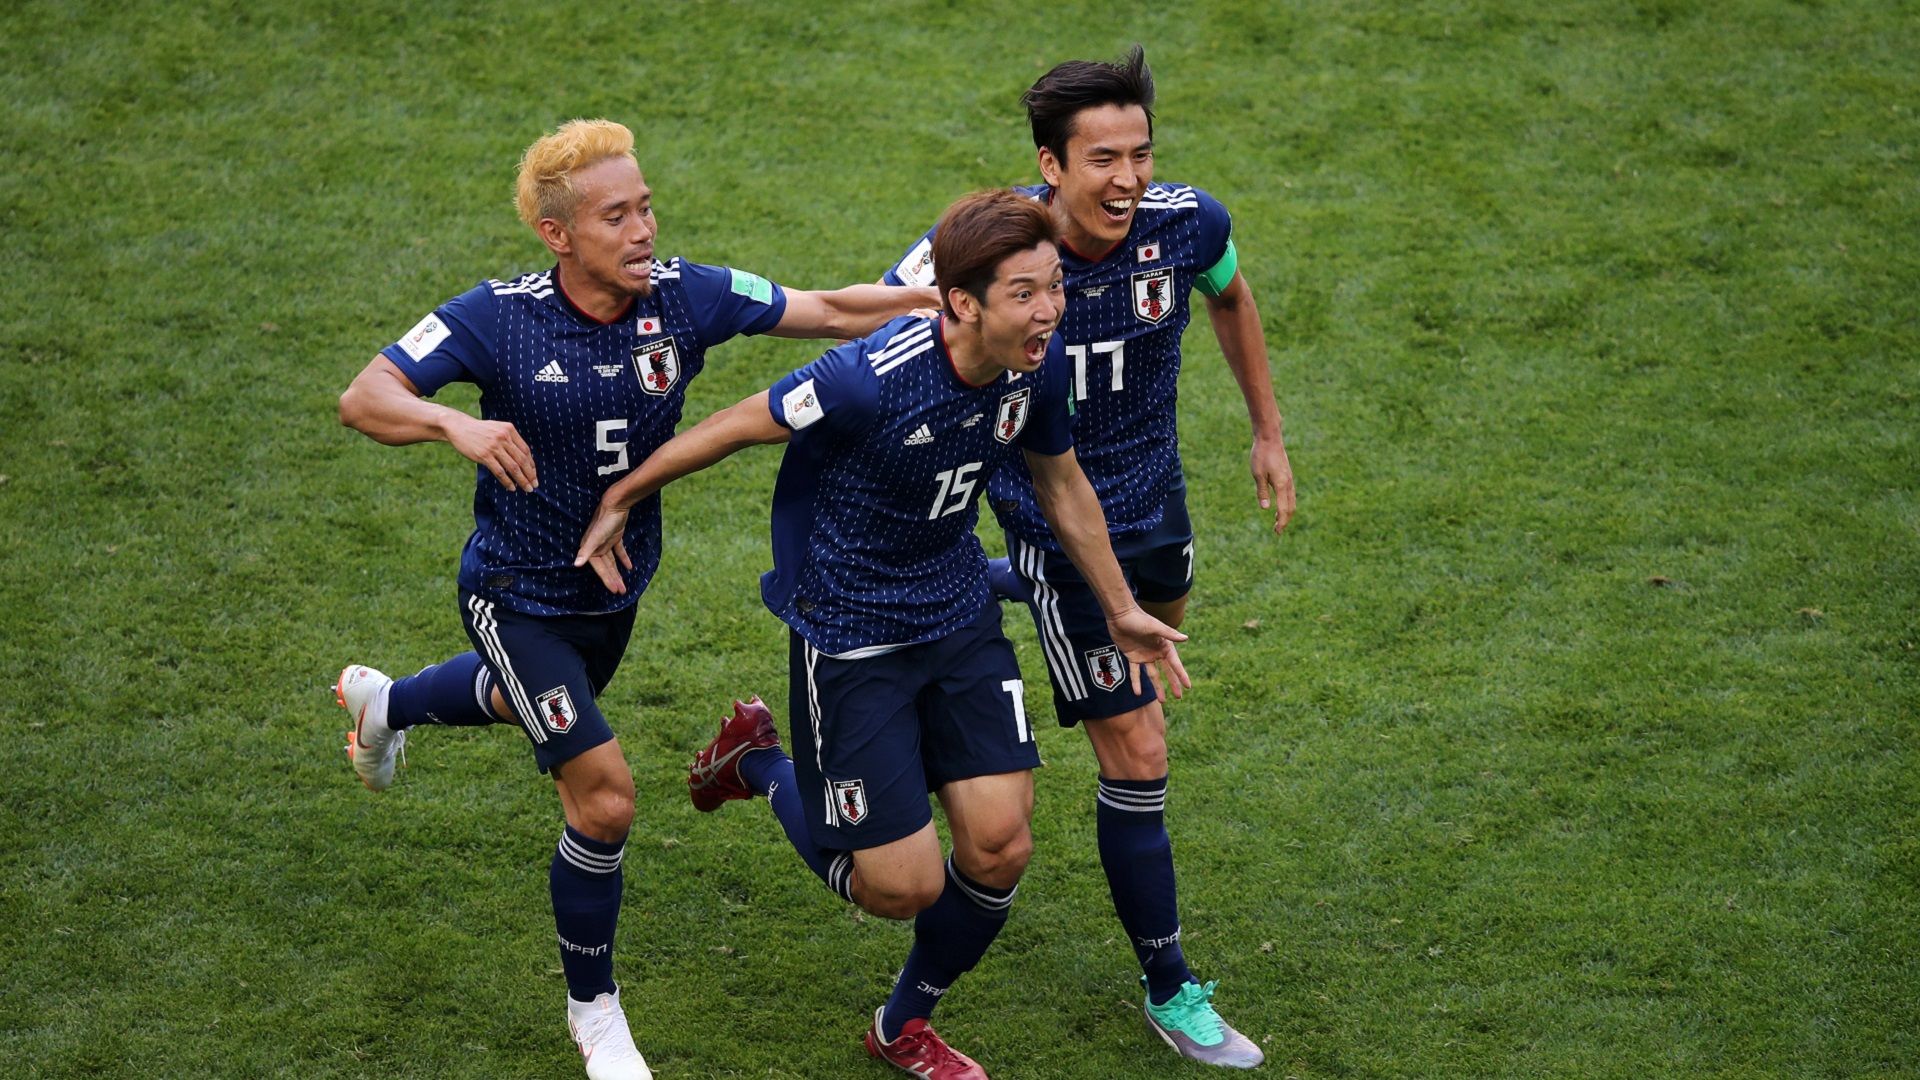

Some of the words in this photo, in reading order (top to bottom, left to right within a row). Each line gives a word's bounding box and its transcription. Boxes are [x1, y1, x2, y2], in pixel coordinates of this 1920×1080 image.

[642, 342, 664, 353] JAPAN
[534, 374, 569, 383] adidas
[1065, 340, 1125, 401] 17
[596, 418, 629, 477] 5
[904, 436, 935, 446] adidas
[928, 461, 983, 521] 15
[1001, 679, 1036, 743] 1
[1137, 925, 1181, 949] JAPA
